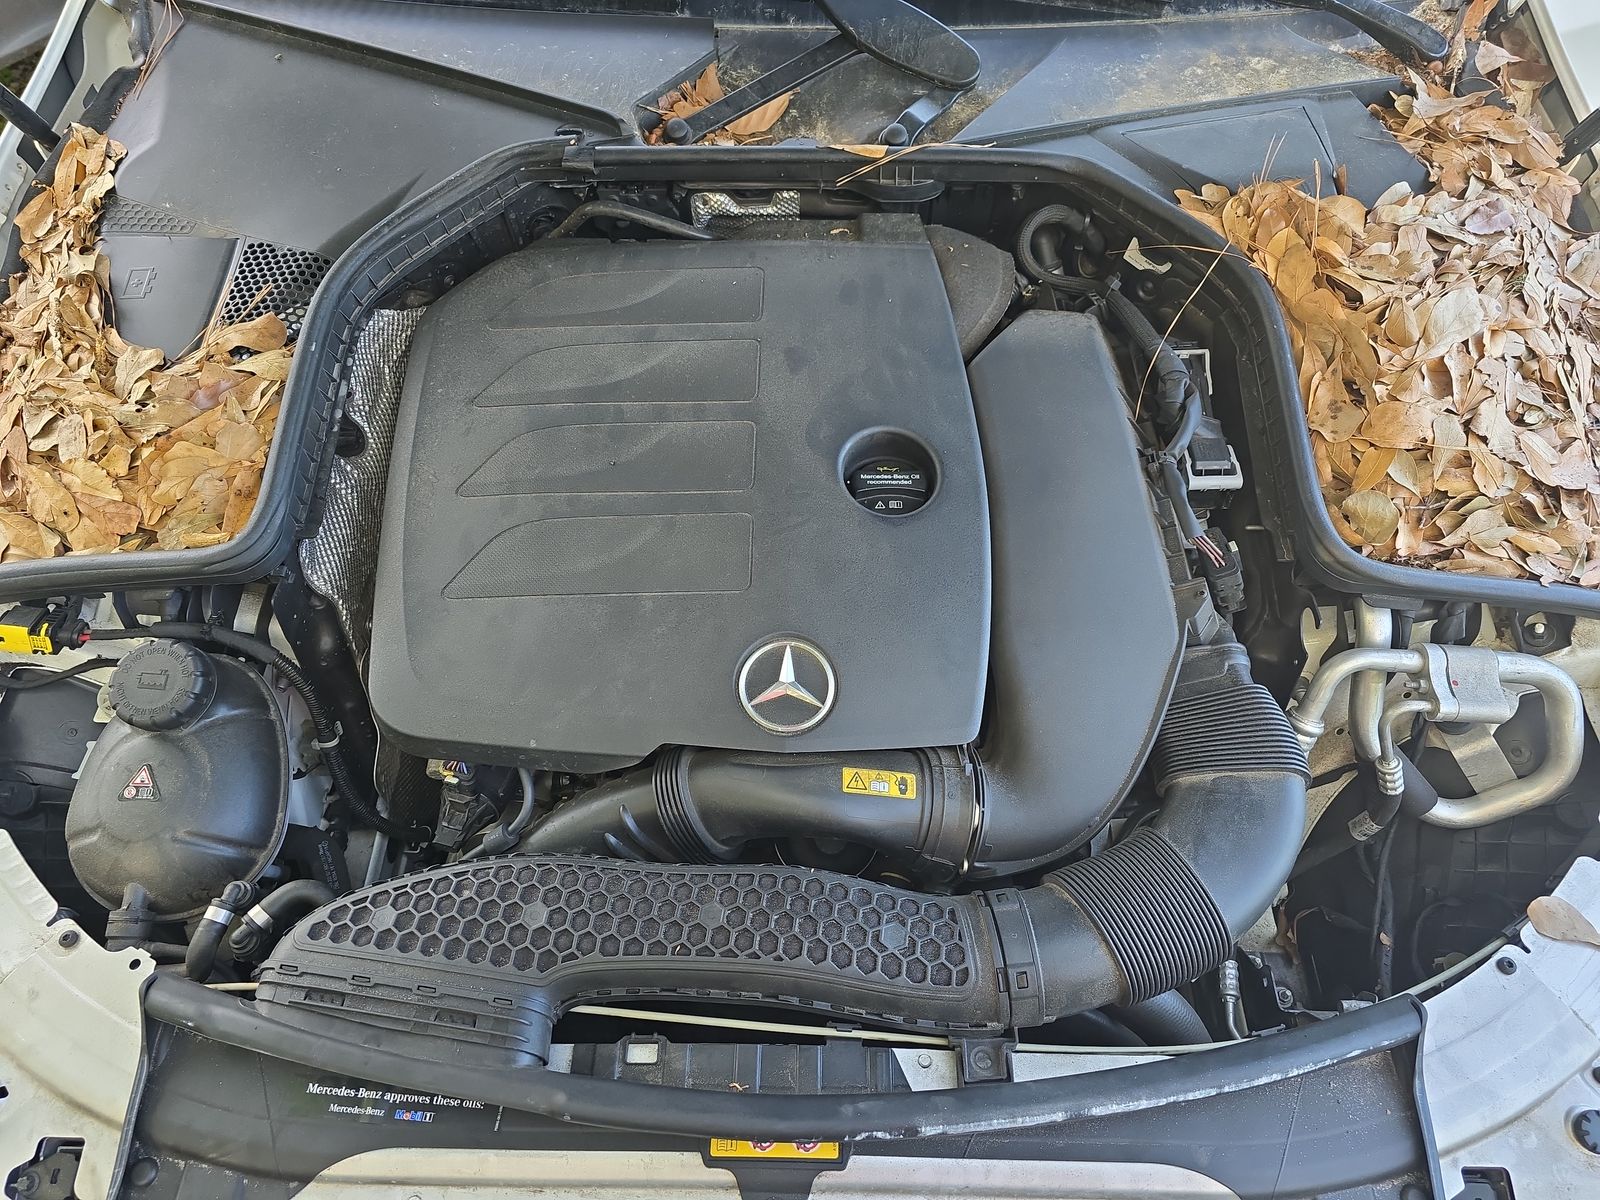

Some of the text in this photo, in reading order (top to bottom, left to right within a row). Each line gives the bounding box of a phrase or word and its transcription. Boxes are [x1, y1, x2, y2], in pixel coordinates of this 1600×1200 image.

[133, 651, 145, 665] NOT
[147, 647, 167, 656] OPEN
[168, 648, 186, 668] WHEN
[180, 664, 192, 679] HOT
[306, 1082, 485, 1109] Mercedes-Benz approves these oils:
[328, 1103, 434, 1122] Mercedes-Benz Mobil 1
